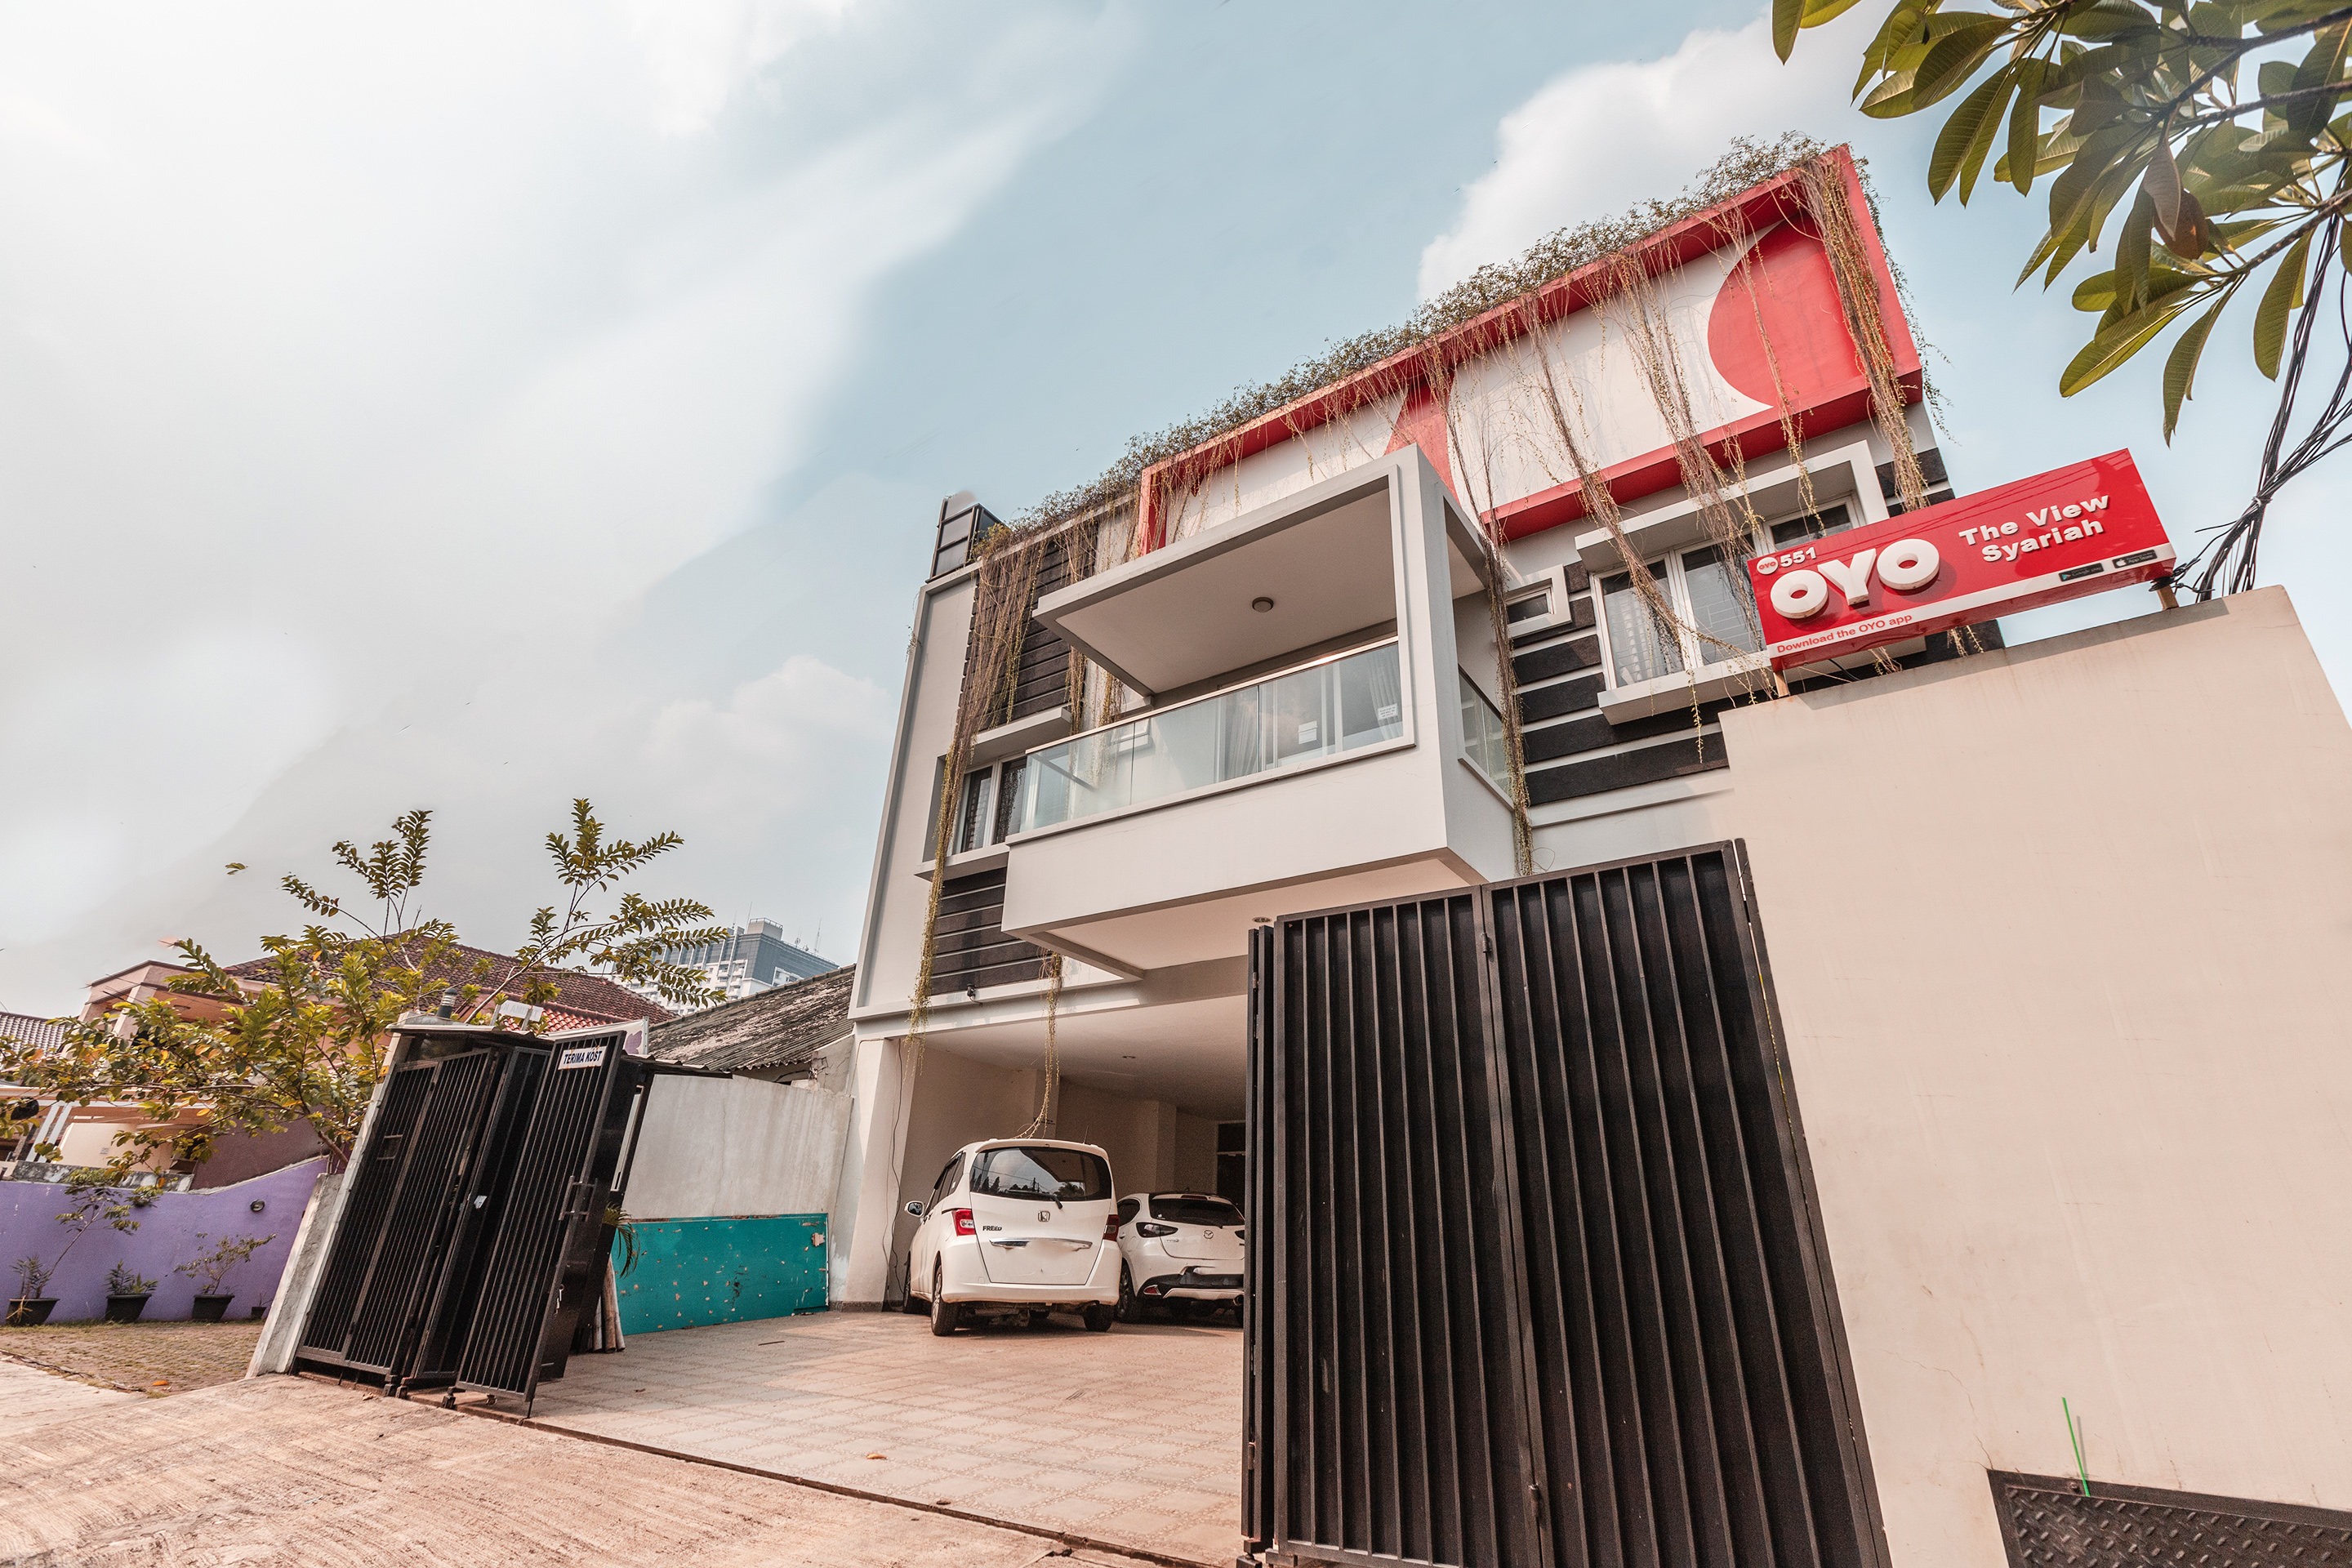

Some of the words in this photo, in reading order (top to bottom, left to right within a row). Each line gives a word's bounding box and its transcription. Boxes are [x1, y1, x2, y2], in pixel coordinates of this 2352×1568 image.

[1958, 521, 2019, 546] The
[2025, 495, 2109, 527] View
[1982, 519, 2104, 562] Syariah
[1758, 560, 1776, 570] OYO
[1780, 546, 1816, 568] 551
[1771, 538, 1940, 619] OYO
[1777, 632, 1834, 653] Download
[1837, 626, 1856, 639] the
[1859, 620, 1886, 633] OYO
[1889, 614, 1913, 626] app
[564, 1052, 585, 1065] TERIMA
[585, 1050, 603, 1062] KOST
